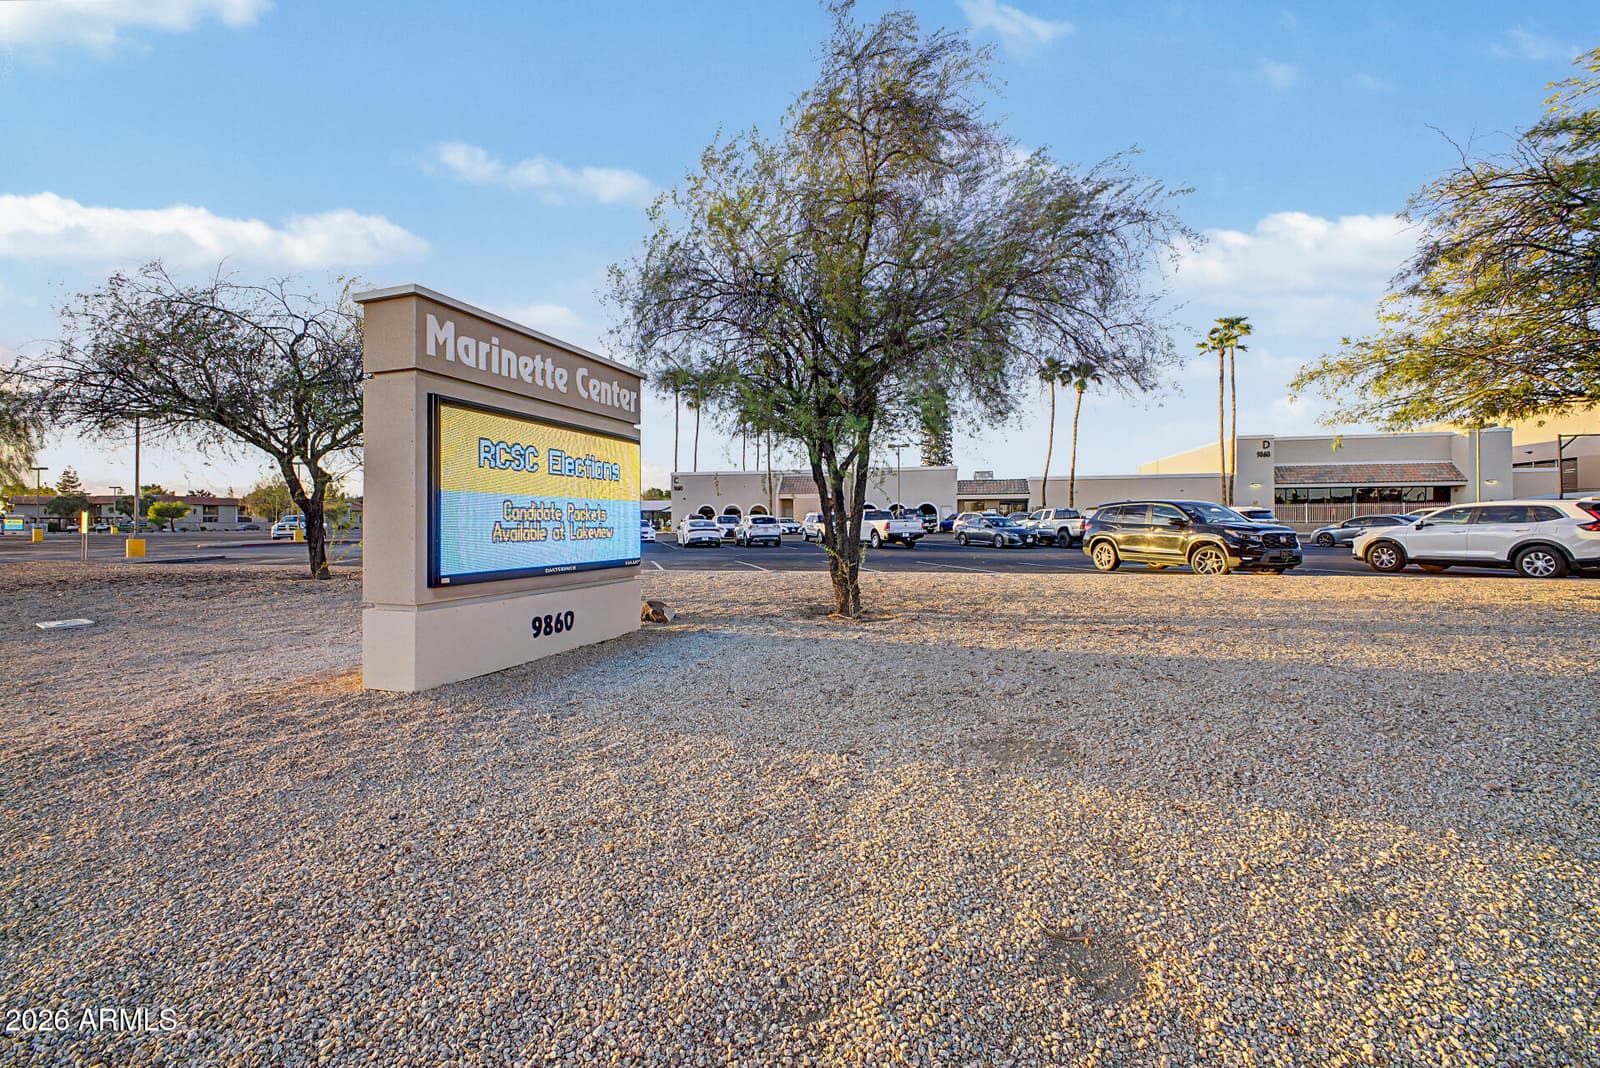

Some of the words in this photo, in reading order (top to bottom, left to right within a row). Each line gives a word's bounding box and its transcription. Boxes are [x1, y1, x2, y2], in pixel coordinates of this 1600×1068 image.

[426, 313, 568, 393] Marinette
[576, 367, 638, 412] Center
[1262, 440, 1271, 449] D
[478, 437, 539, 473] RCSC
[547, 448, 621, 481] Elections
[502, 500, 563, 522] Candidate
[566, 502, 608, 521] Packets
[491, 521, 548, 543] Available
[551, 522, 566, 540] at
[569, 521, 614, 540] Lakeview
[531, 610, 575, 639] 9860
